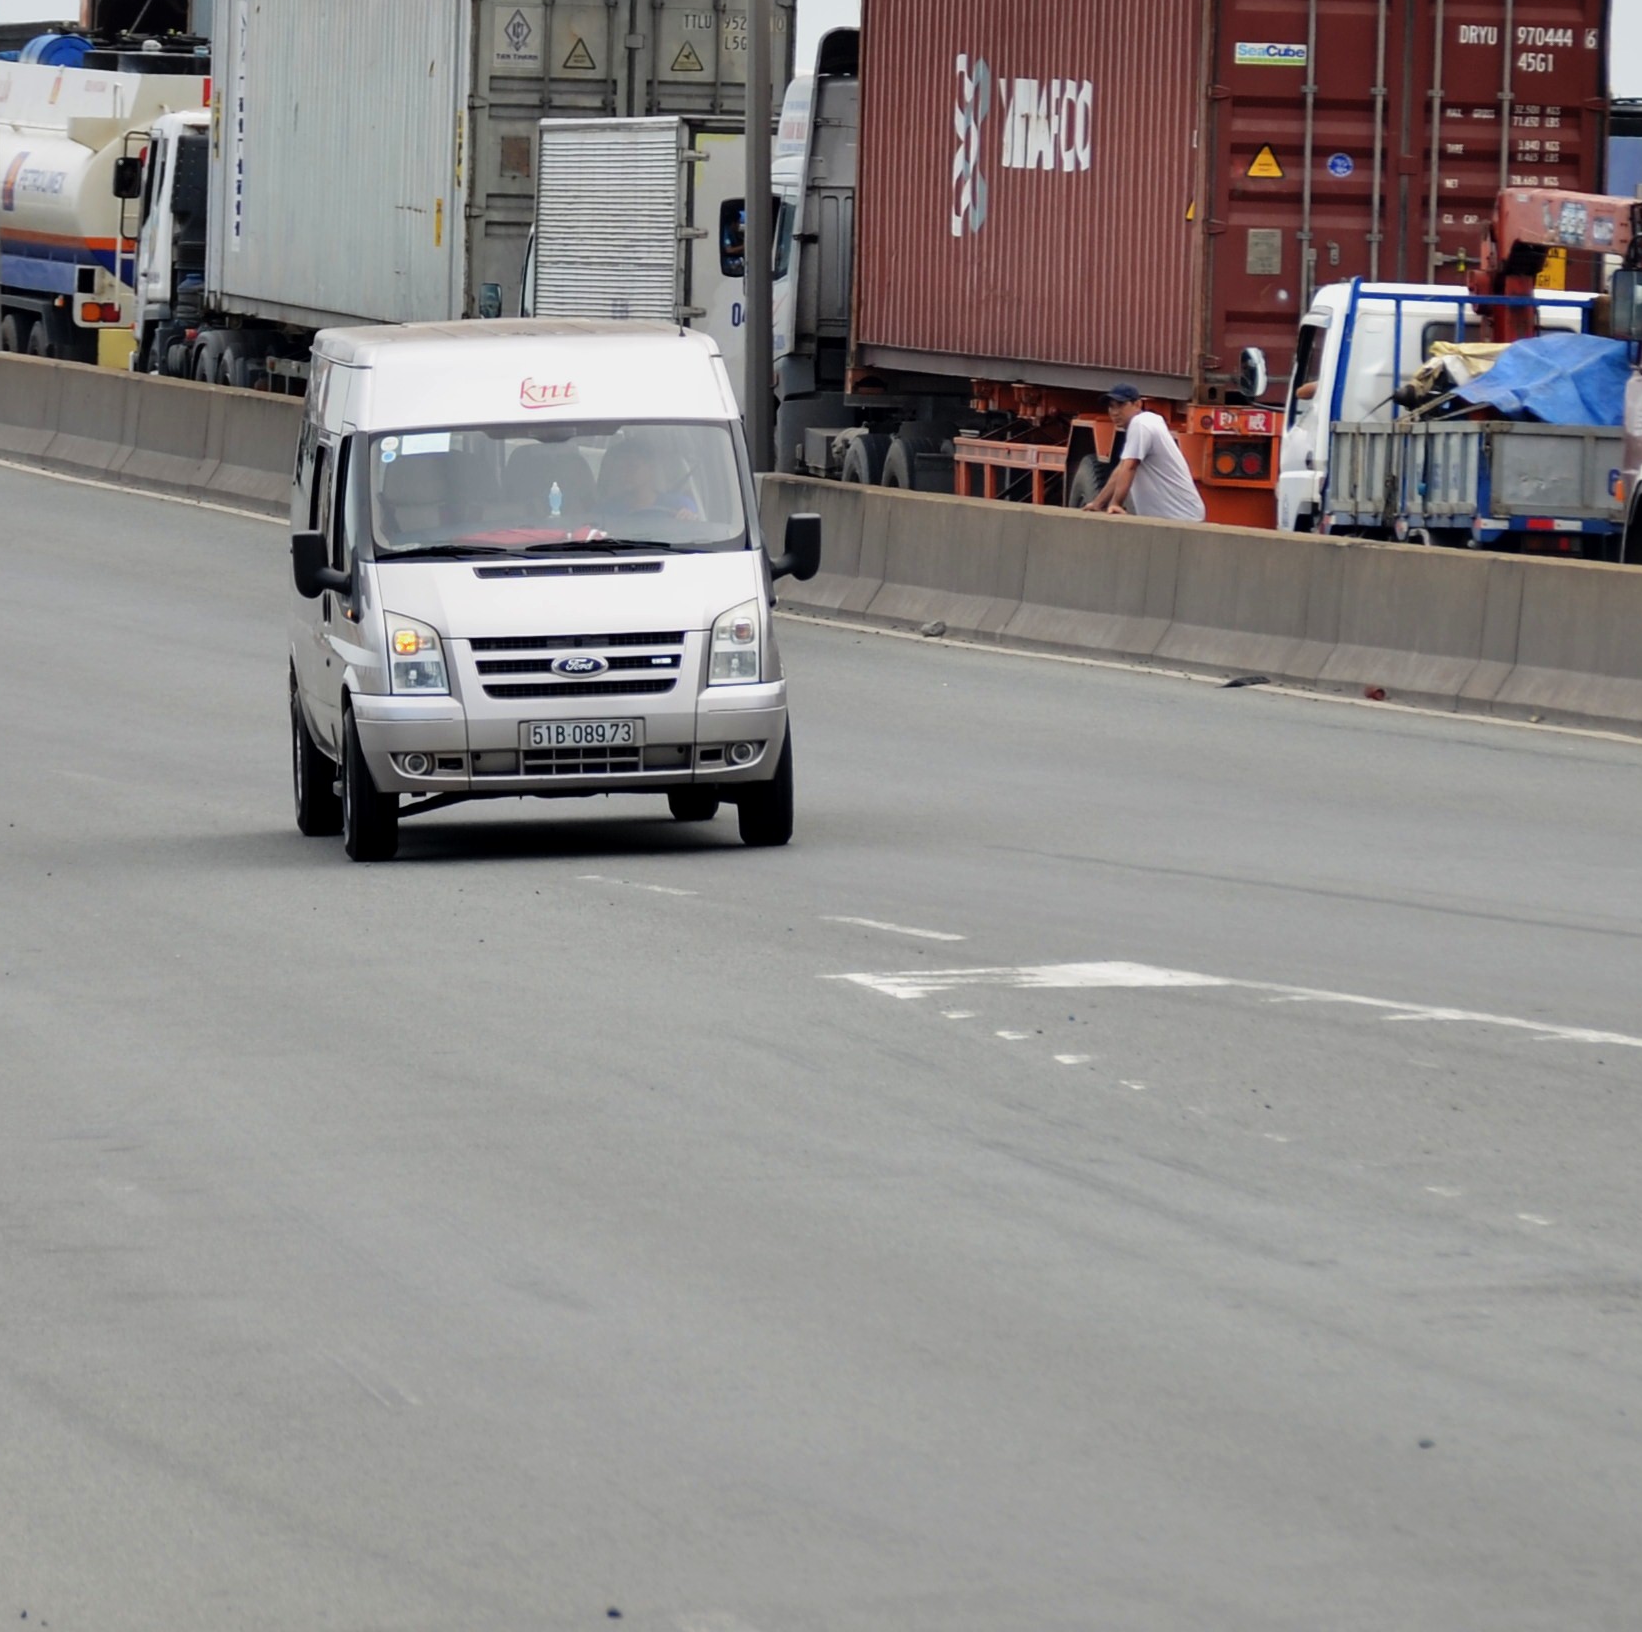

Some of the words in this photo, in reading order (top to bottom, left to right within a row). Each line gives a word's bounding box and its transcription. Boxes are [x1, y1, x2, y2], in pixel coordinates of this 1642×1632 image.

[684, 14, 712, 29] TTLU
[1459, 24, 1498, 45] DRYU
[1517, 26, 1573, 47] 970444
[1586, 30, 1597, 48] 6
[1238, 44, 1306, 58] SeaCube
[1517, 53, 1554, 72] 45G1
[565, 658, 594, 671] Ford
[532, 723, 633, 745] 51B-089.73
